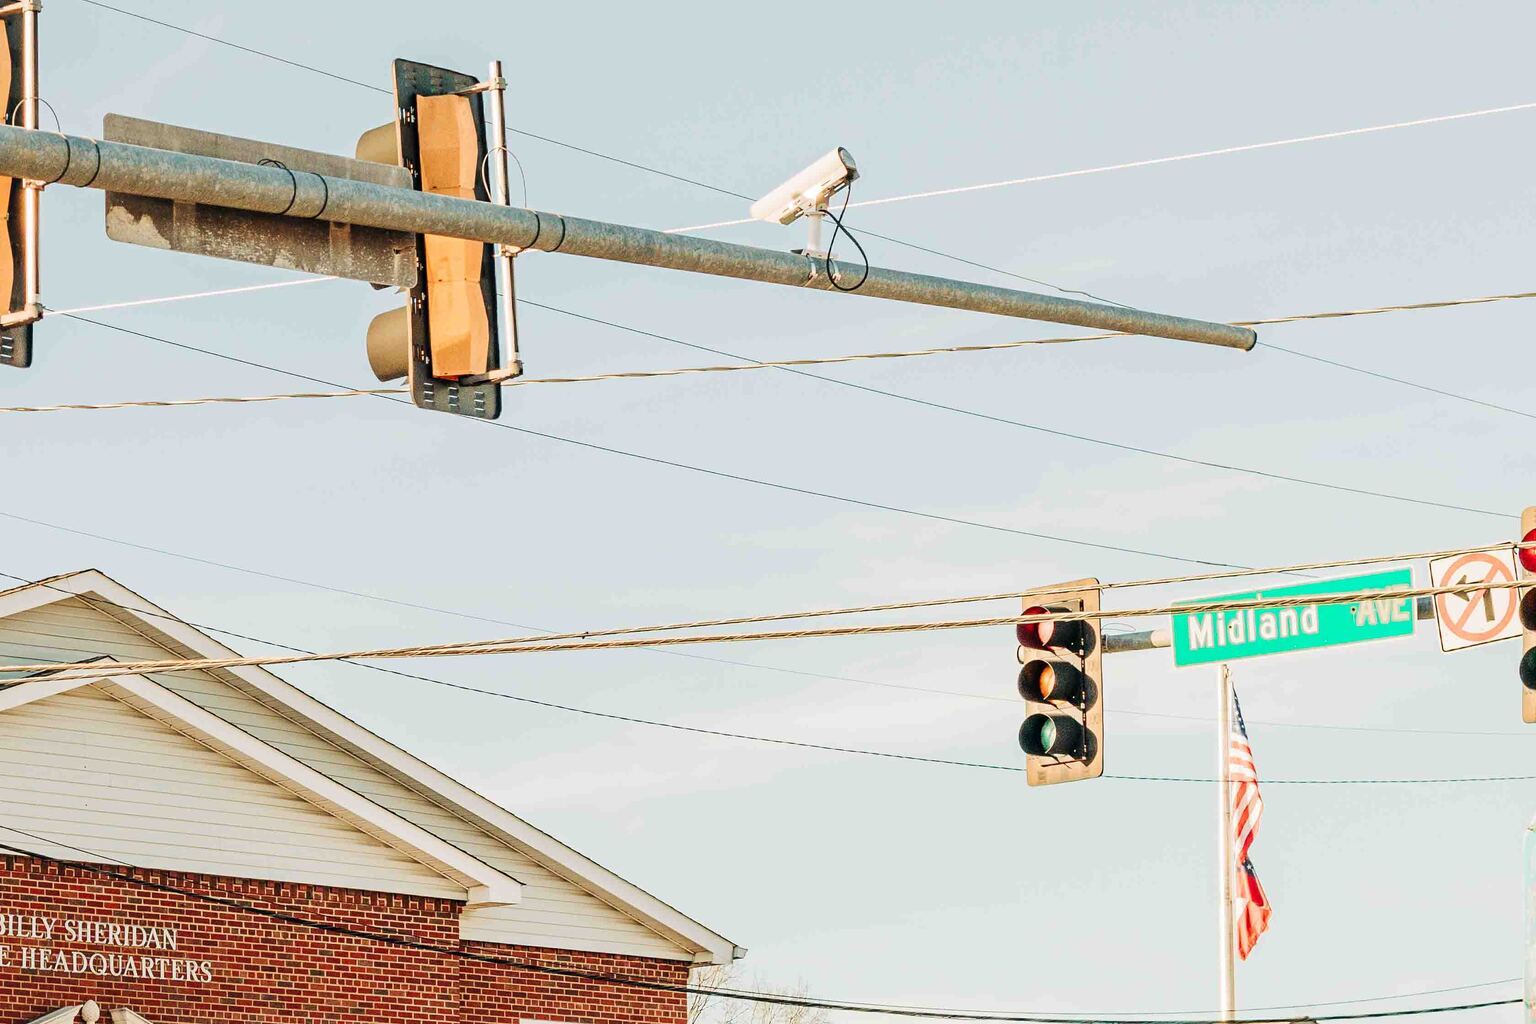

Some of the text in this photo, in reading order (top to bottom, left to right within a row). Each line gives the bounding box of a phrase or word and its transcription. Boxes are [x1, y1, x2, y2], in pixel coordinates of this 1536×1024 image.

[1187, 583, 1411, 651] Midland AVE
[64, 918, 178, 951] SHERIDAN
[20, 946, 213, 984] HEADQUARTERS
